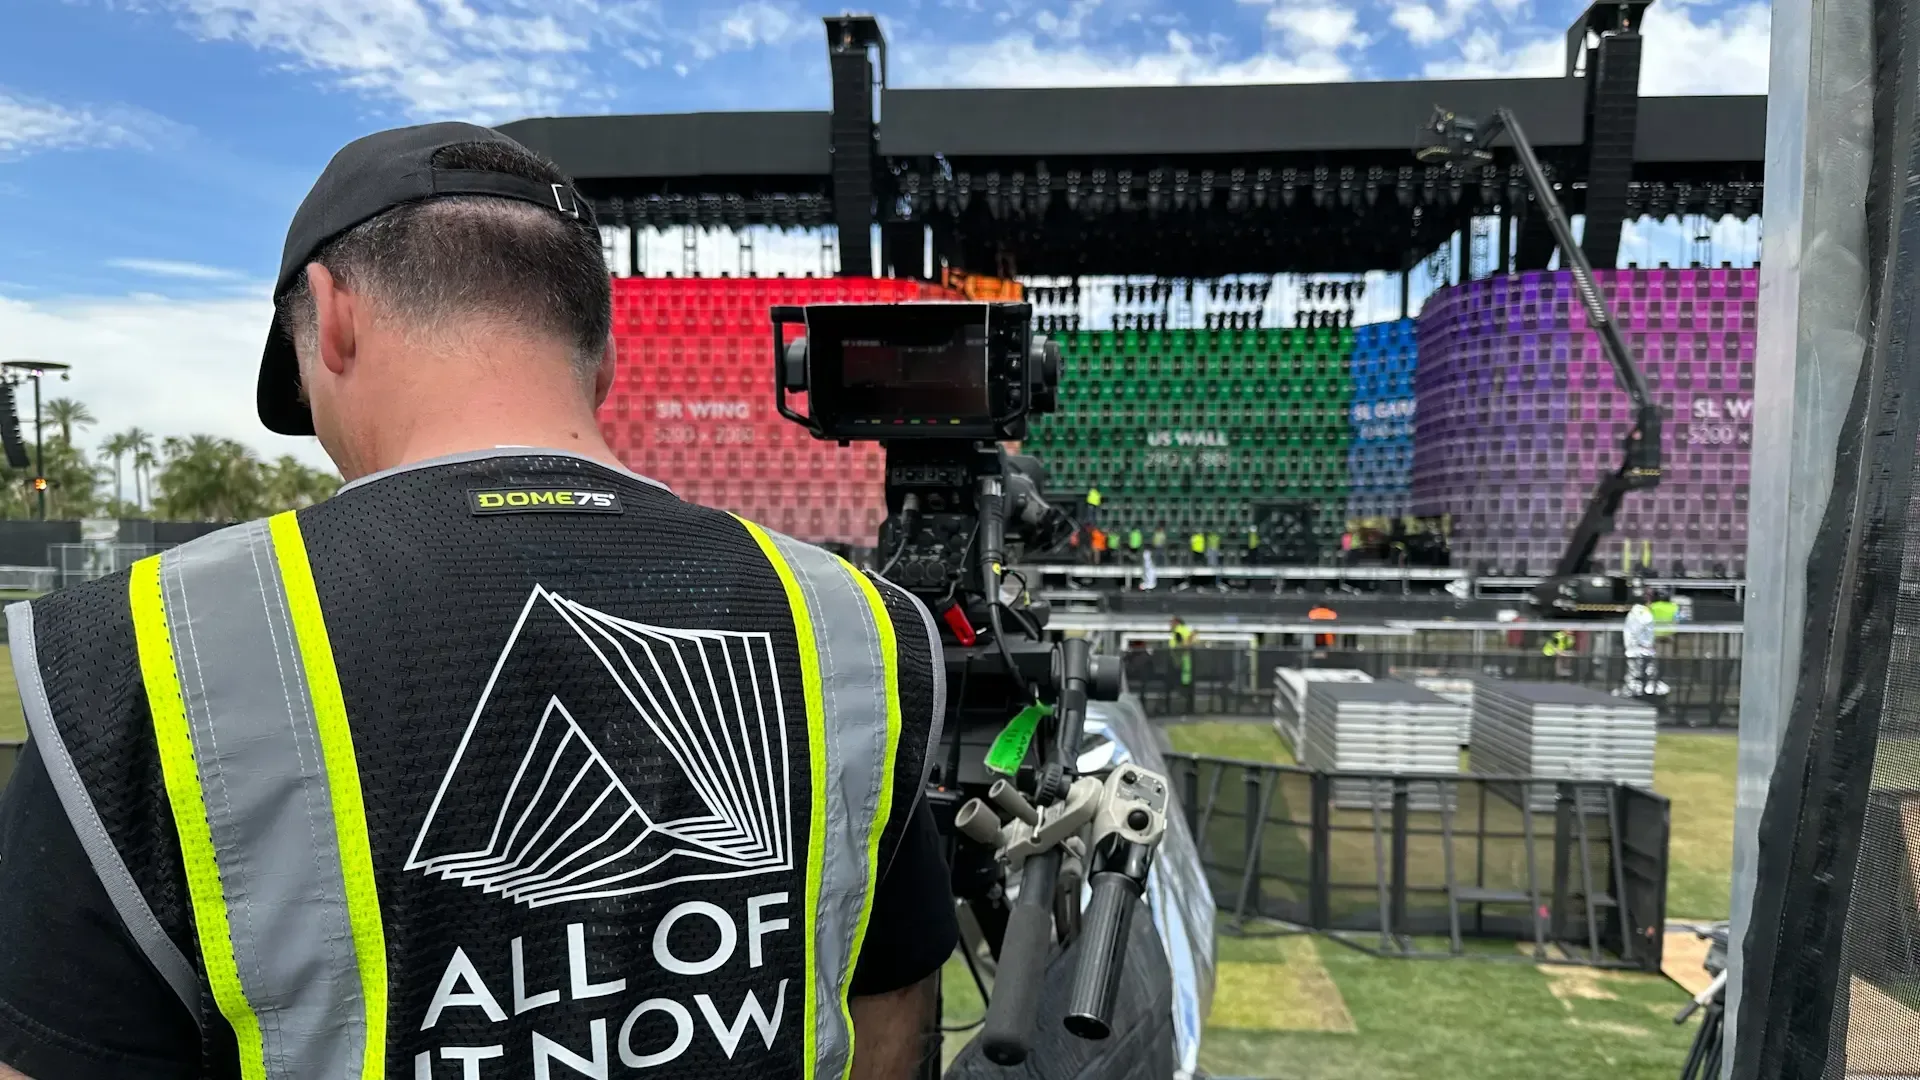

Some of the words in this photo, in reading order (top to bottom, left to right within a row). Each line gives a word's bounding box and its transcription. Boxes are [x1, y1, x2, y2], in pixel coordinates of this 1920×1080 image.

[687, 401, 750, 420] WING
[1146, 431, 1172, 447] US
[1175, 430, 1229, 447] WALL
[420, 922, 627, 1031] ALL
[652, 891, 789, 975] OF
[532, 978, 789, 1080] NOW
